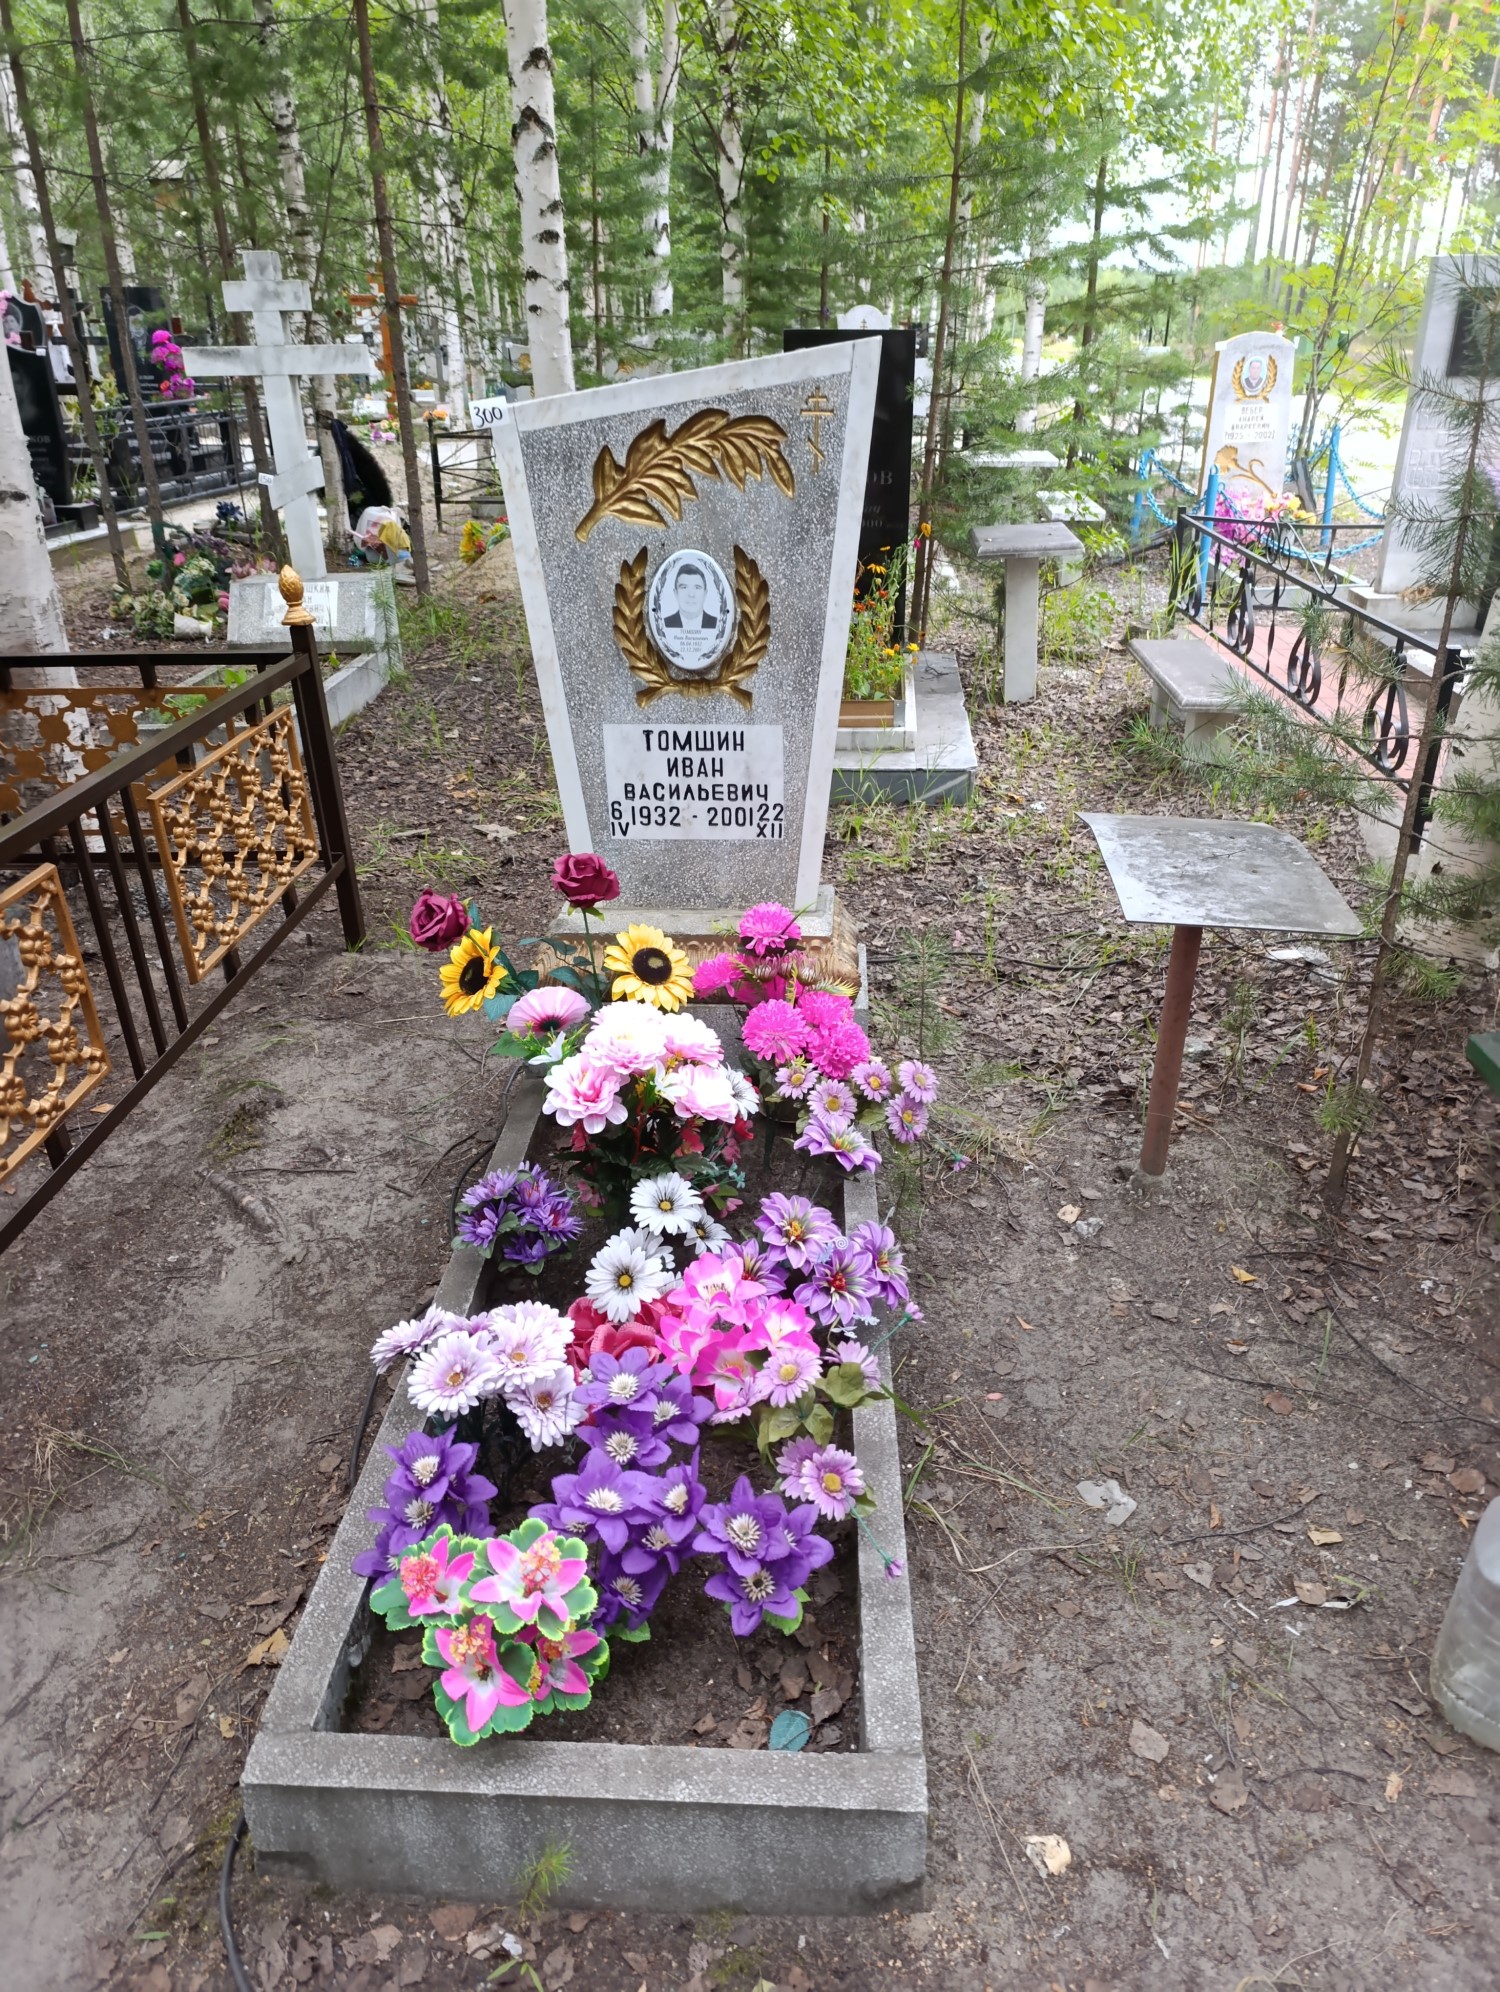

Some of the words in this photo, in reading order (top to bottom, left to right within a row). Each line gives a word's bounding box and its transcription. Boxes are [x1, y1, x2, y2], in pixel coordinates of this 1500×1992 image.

[473, 406, 503, 428] 300
[642, 729, 745, 752] ТОМШИН
[666, 757, 724, 778] ИВАН
[623, 782, 769, 802] ВАСИЛЬЕВИЧ
[610, 800, 623, 820] 6
[631, 805, 681, 827] 1932
[706, 806, 754, 827] 2001
[756, 803, 784, 822] 22
[611, 821, 630, 837] IV
[756, 822, 783, 839] XII
